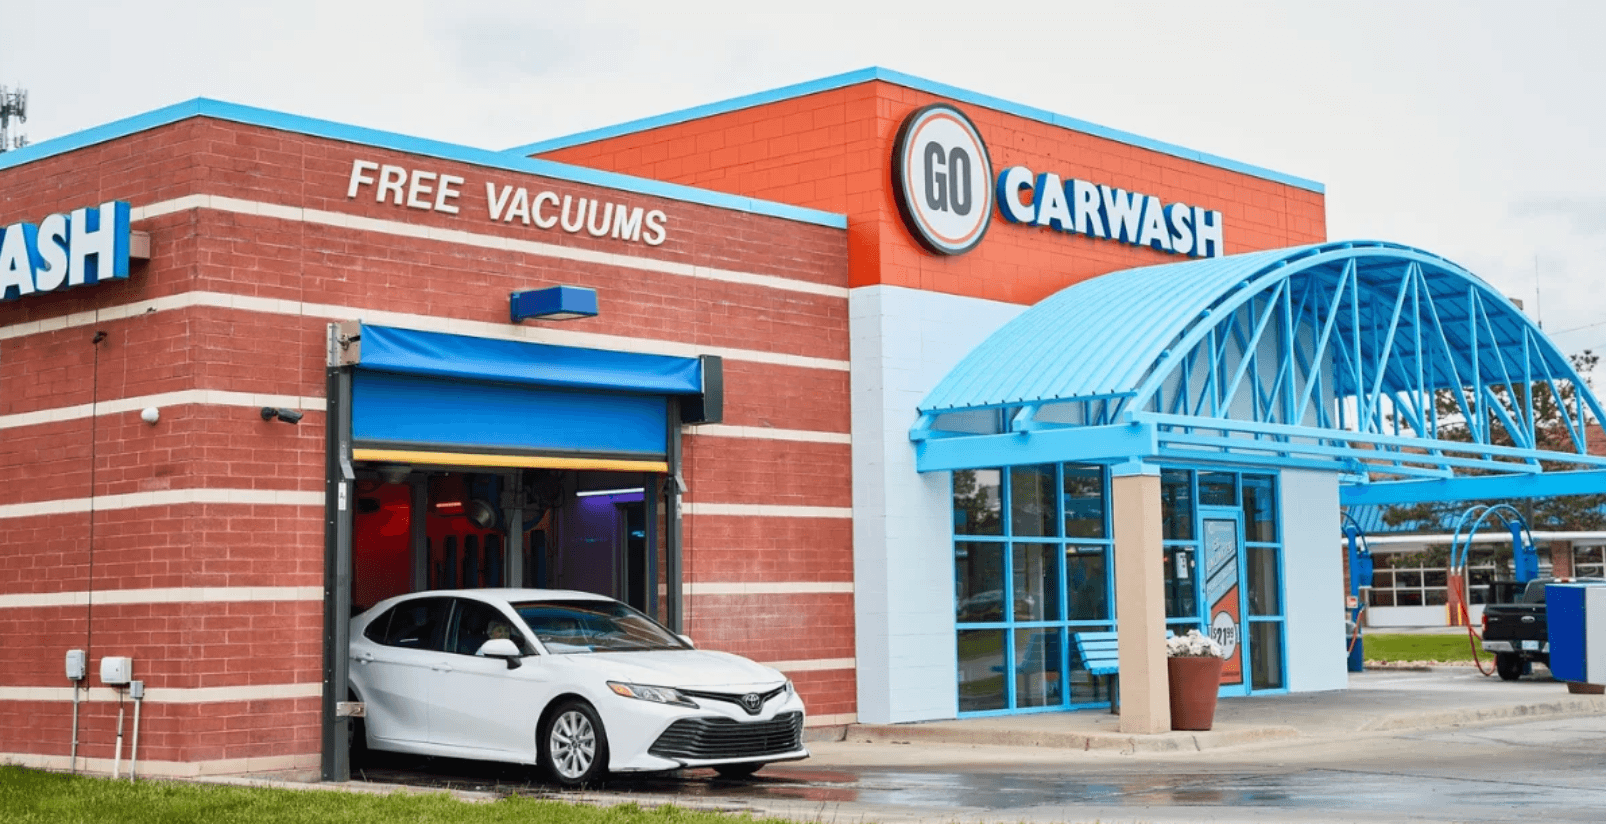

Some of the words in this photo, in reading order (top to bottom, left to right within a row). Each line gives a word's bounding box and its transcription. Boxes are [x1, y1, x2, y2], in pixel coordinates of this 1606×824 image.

[346, 159, 465, 215] FREE
[485, 182, 668, 247] VACUUMS
[924, 141, 972, 216] GO
[998, 166, 1224, 258] CARWASH
